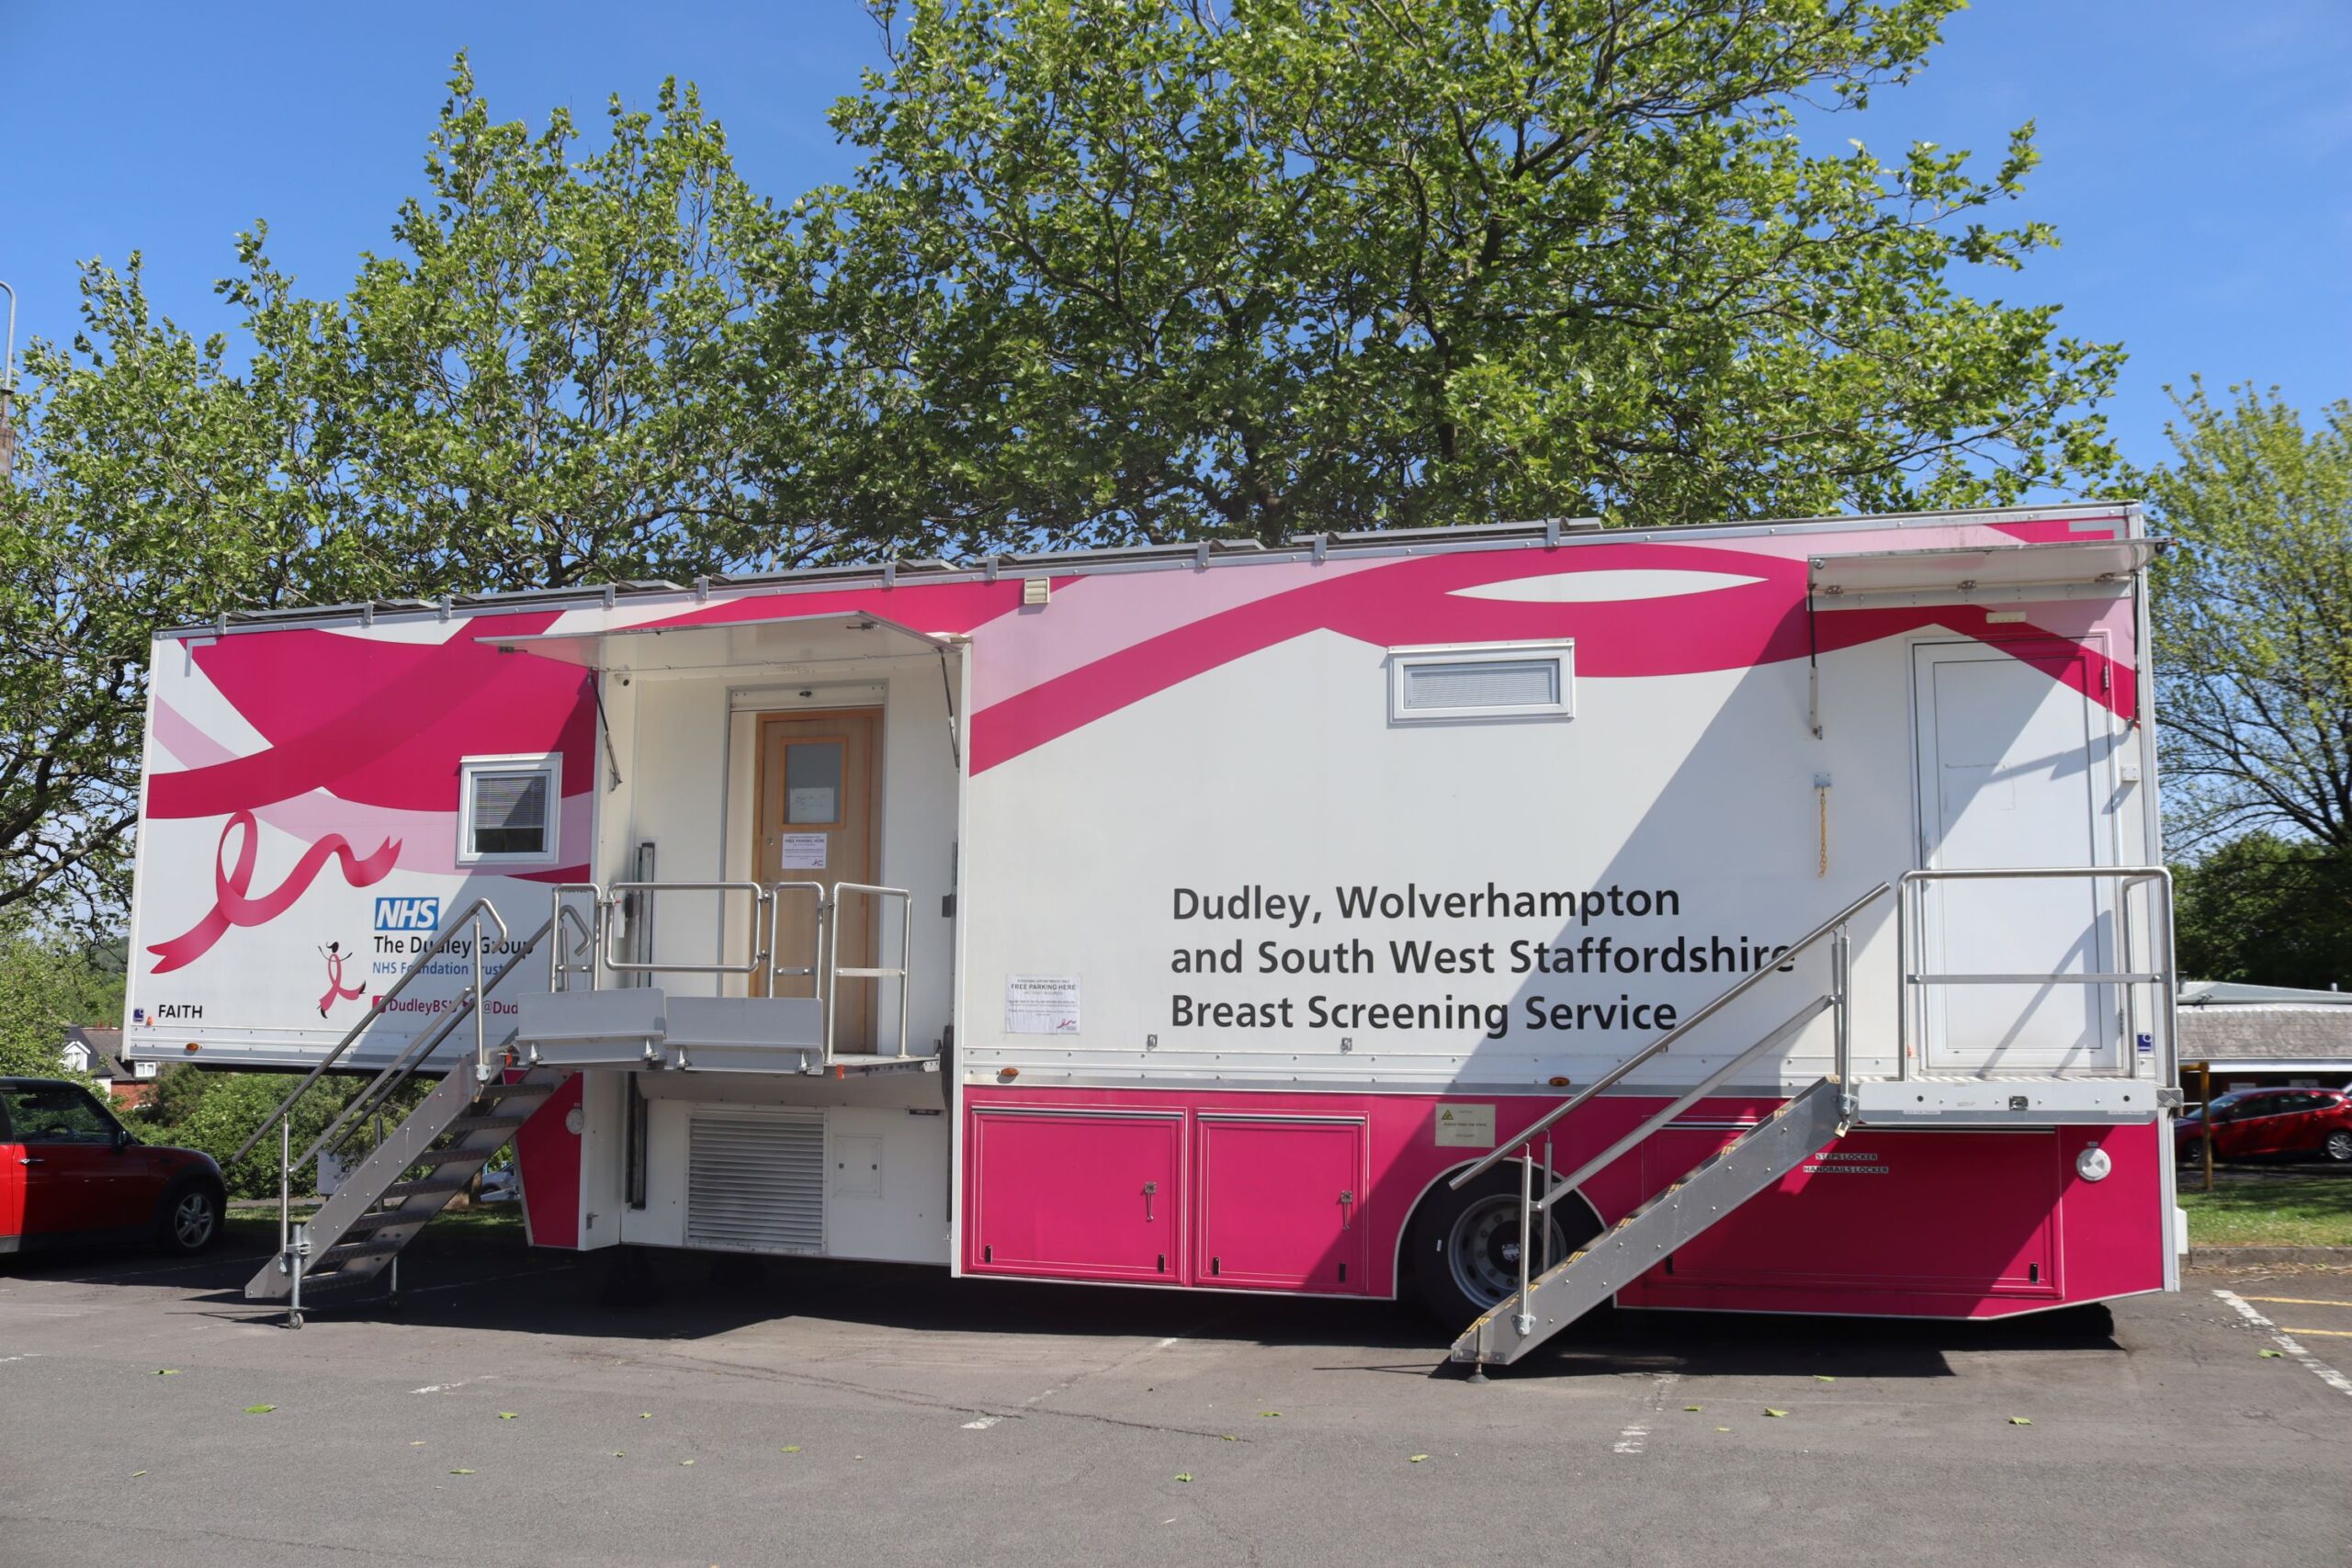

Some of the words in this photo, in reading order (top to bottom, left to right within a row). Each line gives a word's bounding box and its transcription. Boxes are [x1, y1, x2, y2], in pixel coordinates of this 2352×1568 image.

[376, 899, 437, 929] NHS
[1172, 885, 1322, 929] Dudley,
[1335, 882, 1679, 926] Wolverhampton
[374, 936, 404, 953] The
[1171, 938, 1242, 974] and
[1258, 939, 1374, 974] South
[1389, 940, 1495, 974] West
[372, 962, 397, 975] NHS
[401, 961, 469, 975] Fondation
[158, 1004, 203, 1019] FAITH
[1171, 994, 1294, 1028] Breast
[1308, 994, 1509, 1039] Screening
[1525, 994, 1677, 1031] Service
